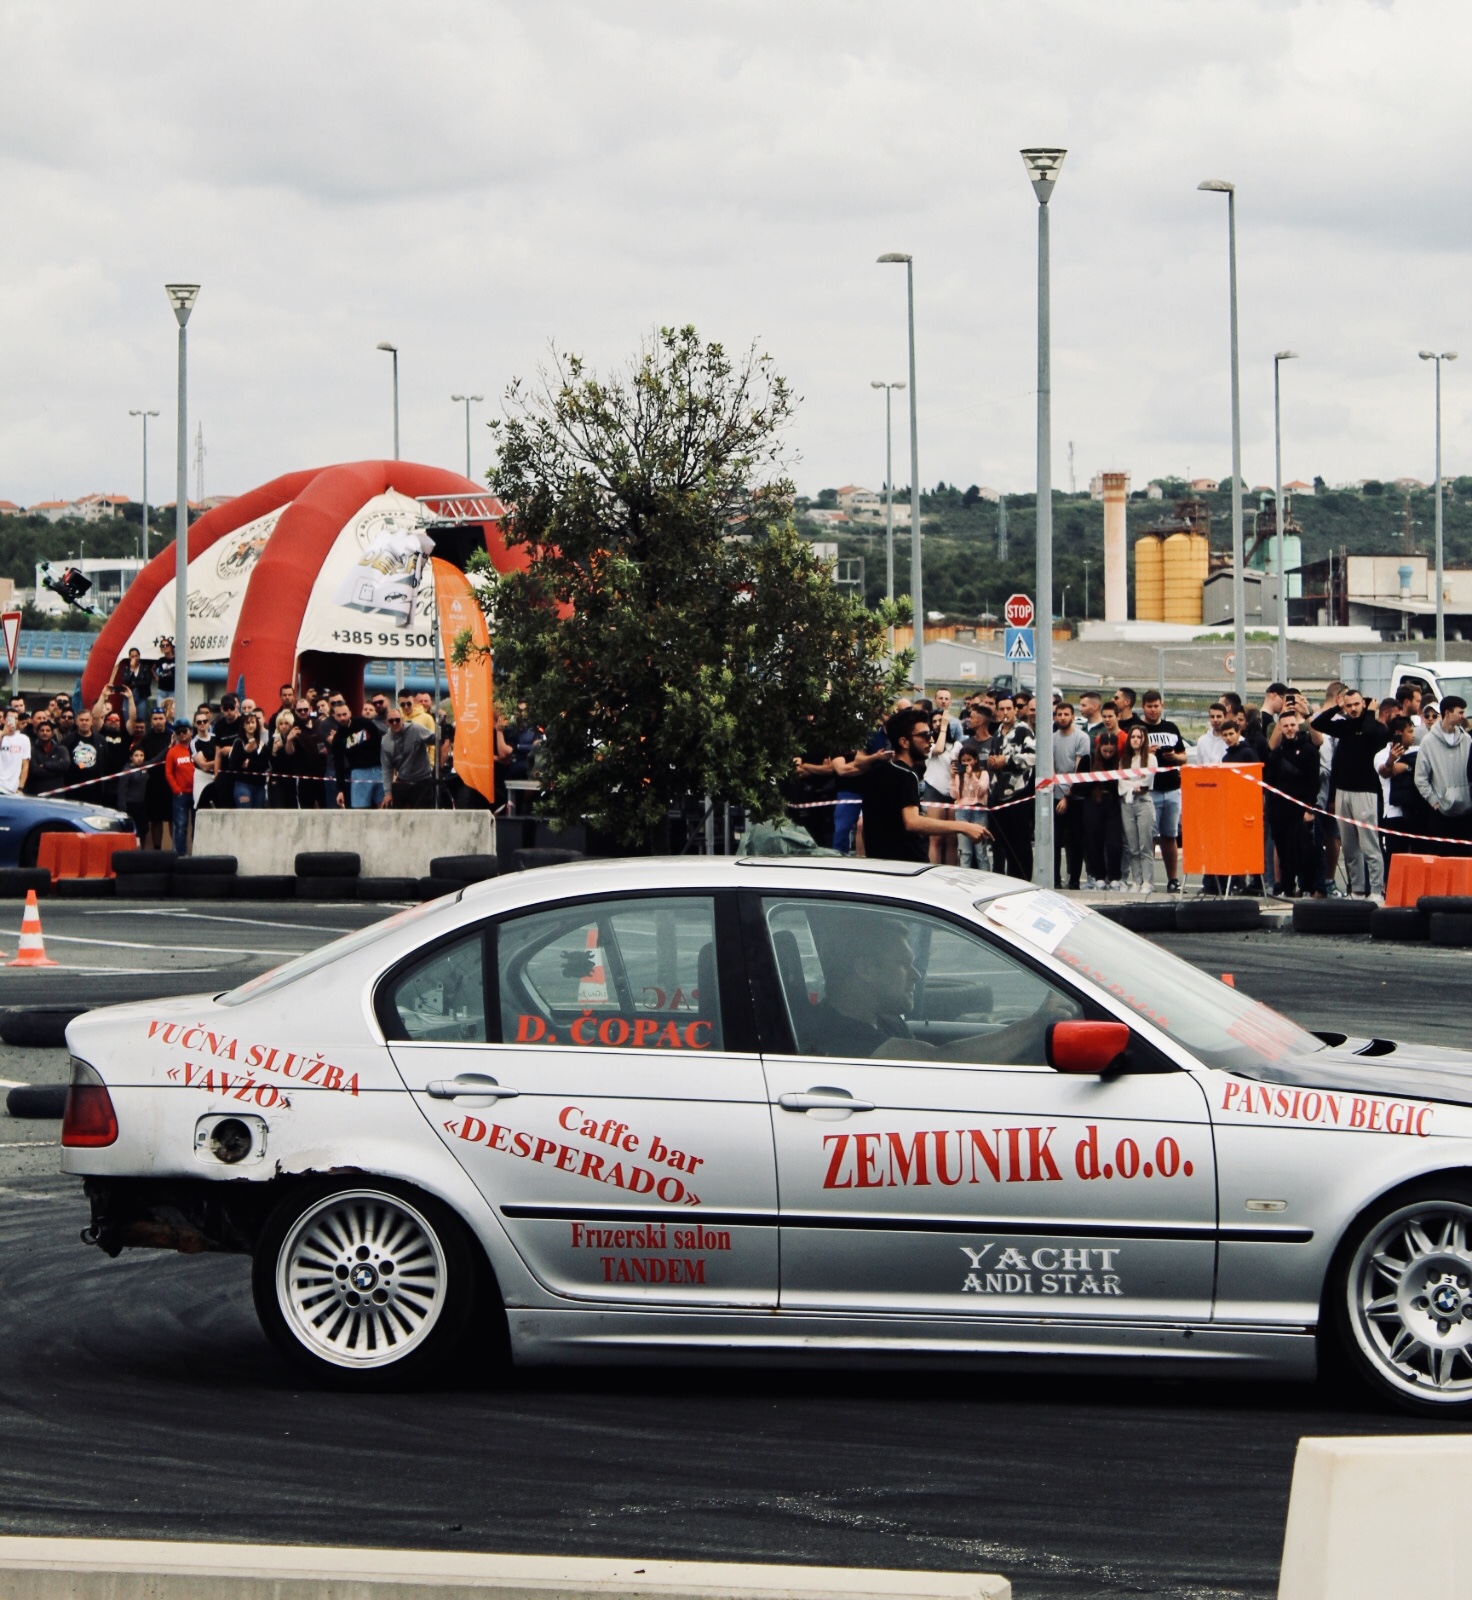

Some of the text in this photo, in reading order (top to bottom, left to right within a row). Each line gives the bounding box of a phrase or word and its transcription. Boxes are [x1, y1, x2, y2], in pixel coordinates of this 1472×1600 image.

[1007, 605, 1032, 619] STOP
[332, 630, 373, 645] +385
[378, 633, 400, 647] 95
[515, 1008, 713, 1049] D. ČOPAC
[148, 1020, 360, 1098] VUČNA SLUŽBA
[1221, 1081, 1435, 1138] PANSION BEGIĆ
[558, 1106, 705, 1176] Caffe bar
[822, 1125, 1195, 1190] ZEMUNIK d.o.o.
[673, 1224, 732, 1251] salon
[600, 1257, 707, 1285] TANDEM
[959, 1243, 1121, 1272] YACHT
[961, 1273, 1125, 1297] ANDI STAR
